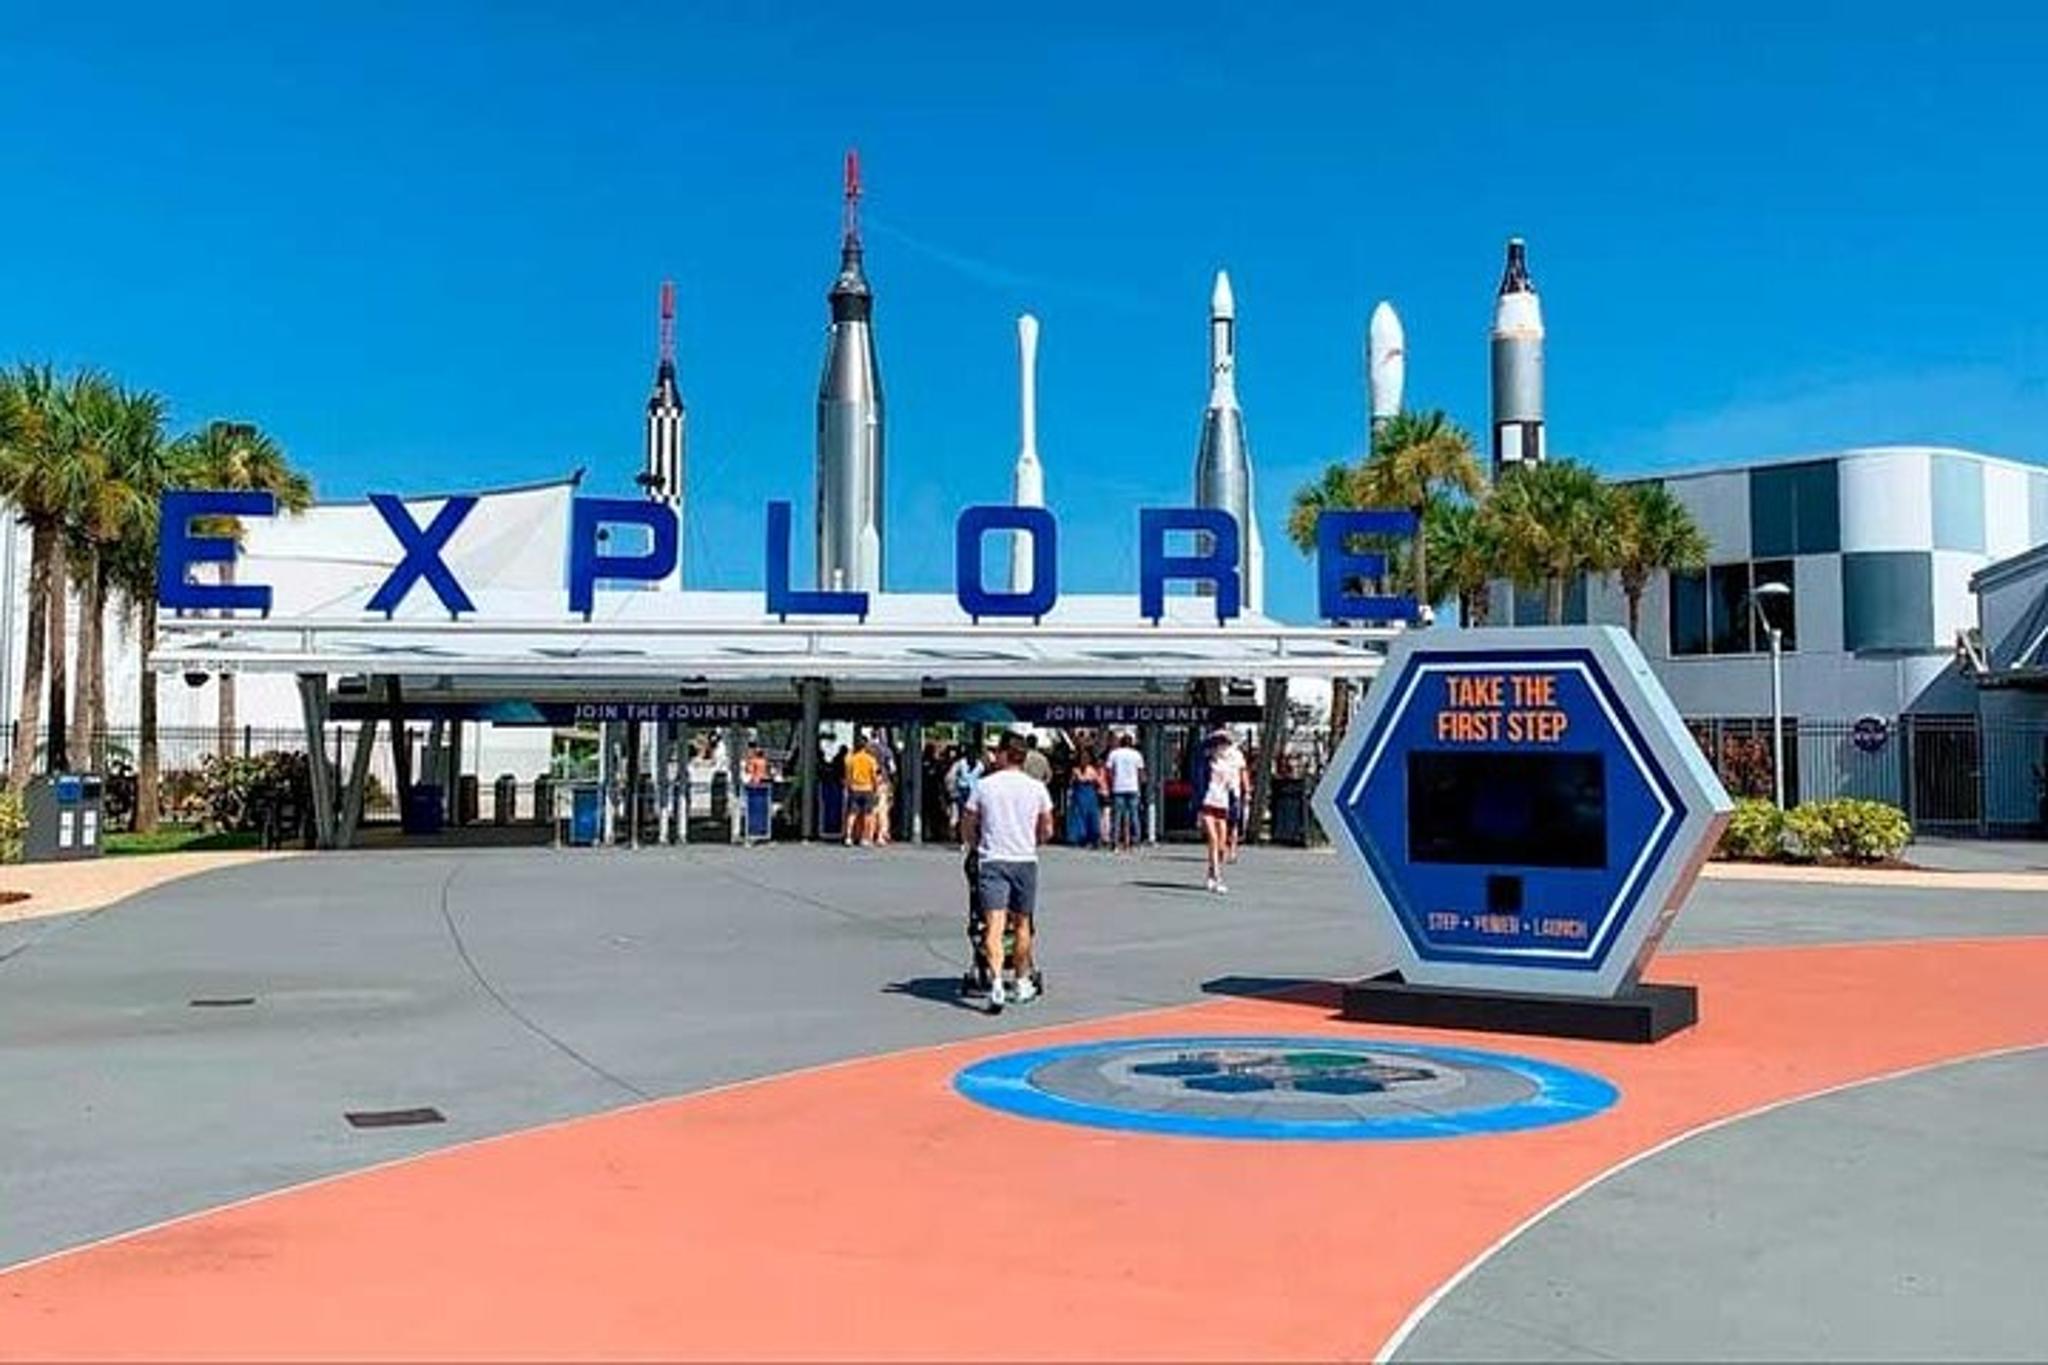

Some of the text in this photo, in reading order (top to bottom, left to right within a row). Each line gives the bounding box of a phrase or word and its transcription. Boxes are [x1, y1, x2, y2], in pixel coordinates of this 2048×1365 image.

[159, 490, 1418, 618] EXPLORE
[1446, 676, 1557, 706] TAKE THE
[574, 704, 750, 719] JOIN THE JOURNEY
[1045, 706, 1209, 721] JOIN THE JOURNEY
[1438, 712, 1568, 742] FIRST STEP
